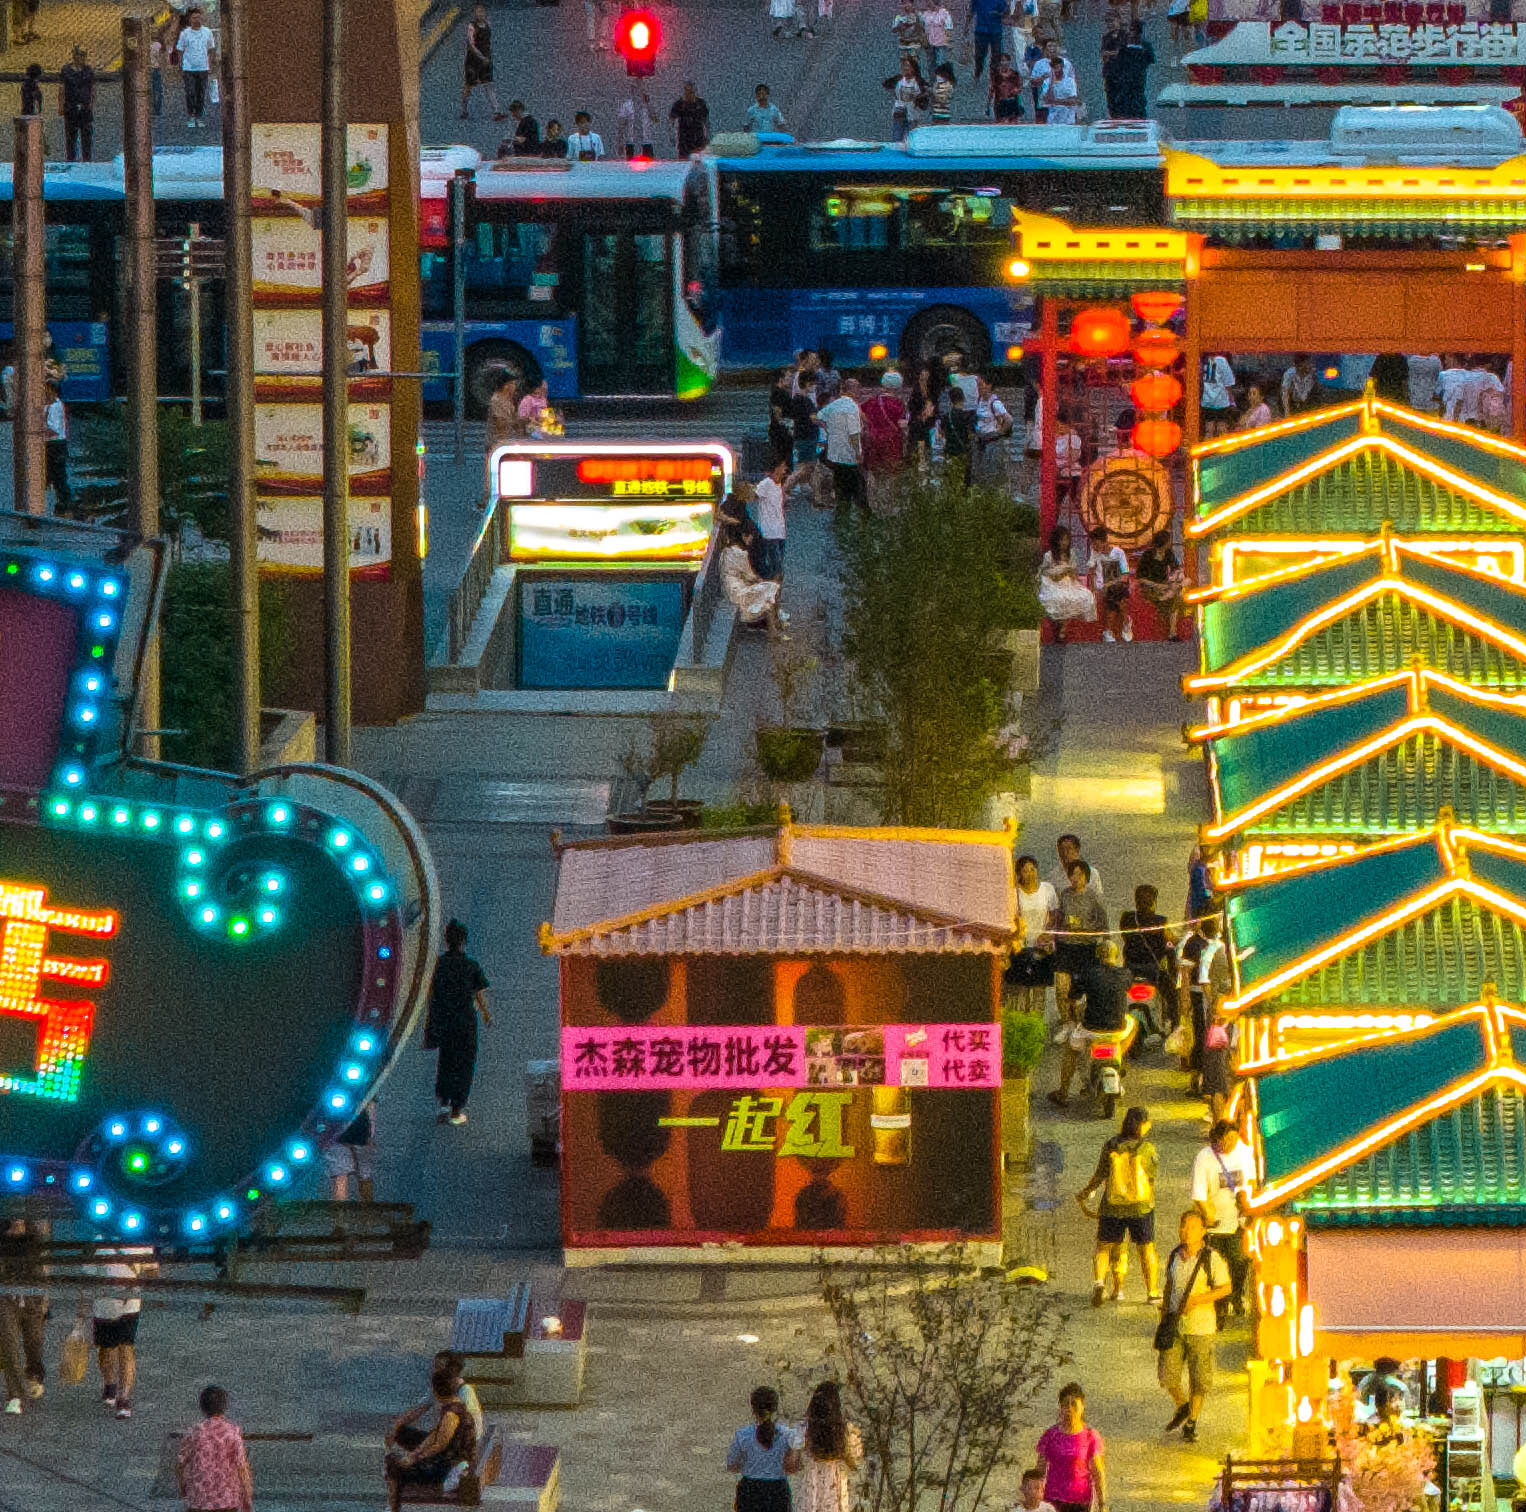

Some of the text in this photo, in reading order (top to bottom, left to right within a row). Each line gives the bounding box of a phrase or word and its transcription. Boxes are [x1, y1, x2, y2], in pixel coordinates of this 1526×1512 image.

[942, 1030, 991, 1053] 代买
[574, 1035, 798, 1078] 杰森宠物批发
[942, 1060, 991, 1082] 代卖
